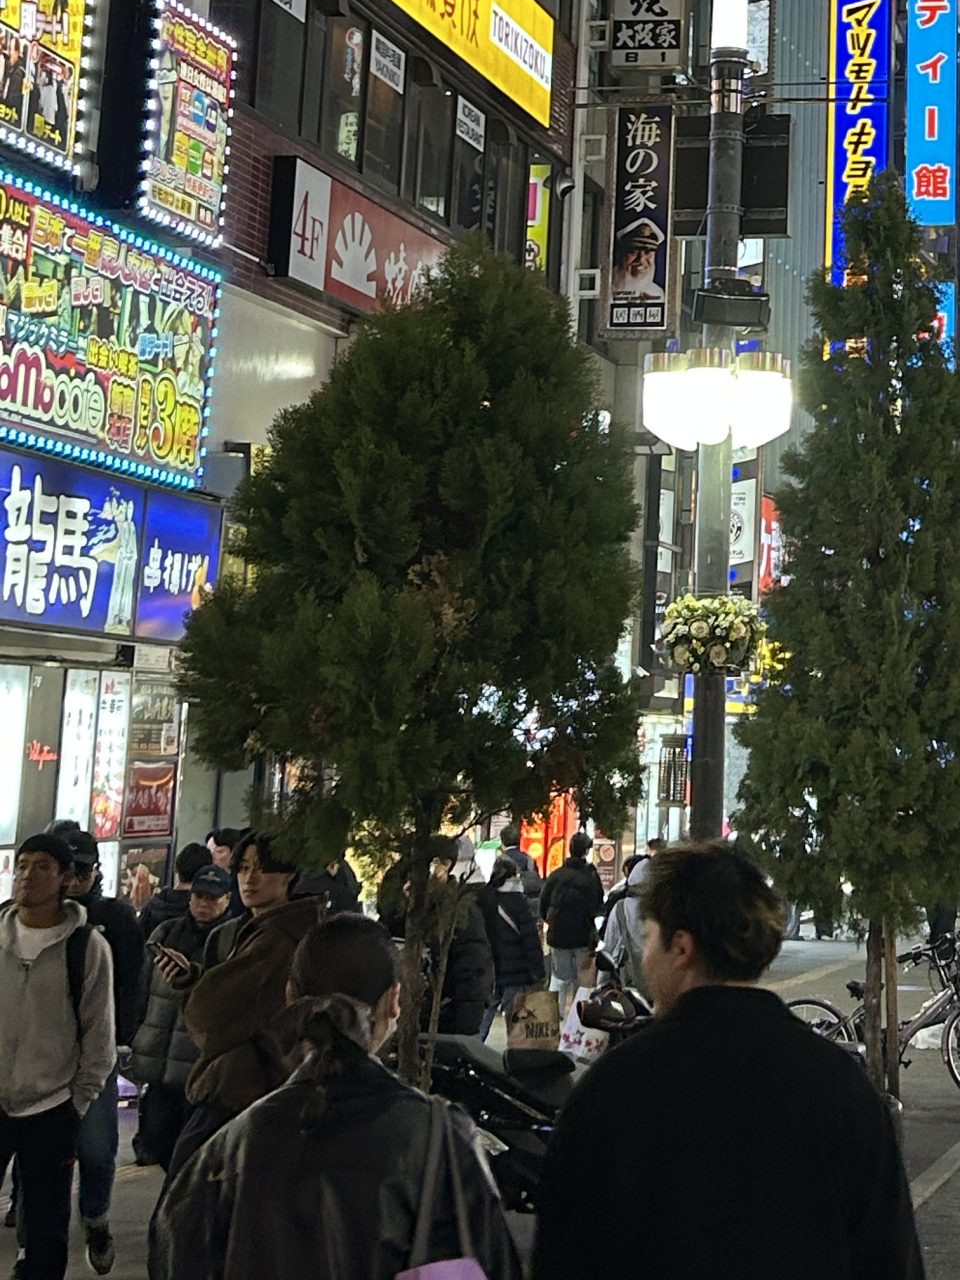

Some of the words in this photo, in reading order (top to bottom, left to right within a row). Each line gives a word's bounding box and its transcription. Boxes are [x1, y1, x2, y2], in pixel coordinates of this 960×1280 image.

[491, 8, 547, 82] TORIKIZOKU
[616, 23, 677, 49] 大阪家
[623, 113, 662, 213] 海の家
[293, 191, 324, 262] 4F
[4, 463, 99, 619] 龍馬
